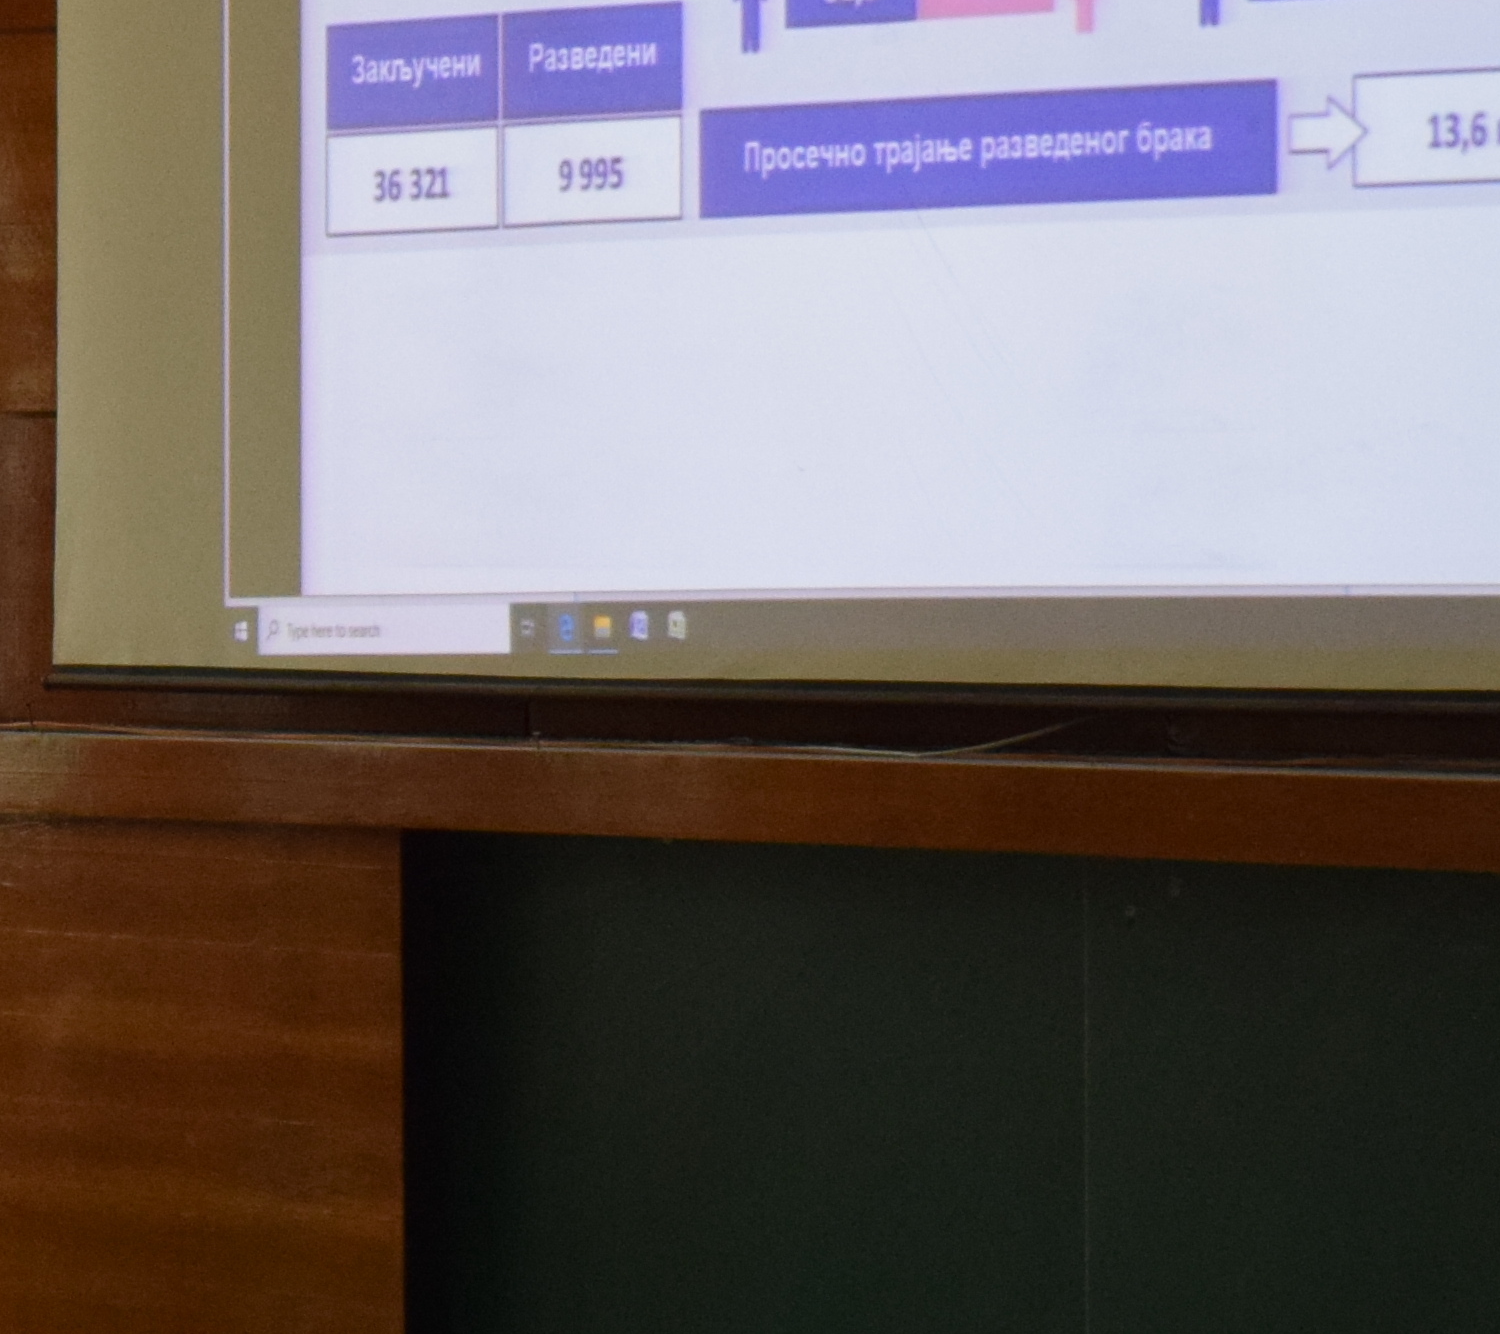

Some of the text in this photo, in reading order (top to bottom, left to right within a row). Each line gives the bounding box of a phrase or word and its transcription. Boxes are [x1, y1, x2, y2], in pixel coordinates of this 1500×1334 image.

[352, 52, 482, 89] Закључени
[528, 40, 658, 73] Разведени
[743, 122, 1213, 180] Просечно трајање разведеног брака
[1428, 112, 1488, 155] 13,6
